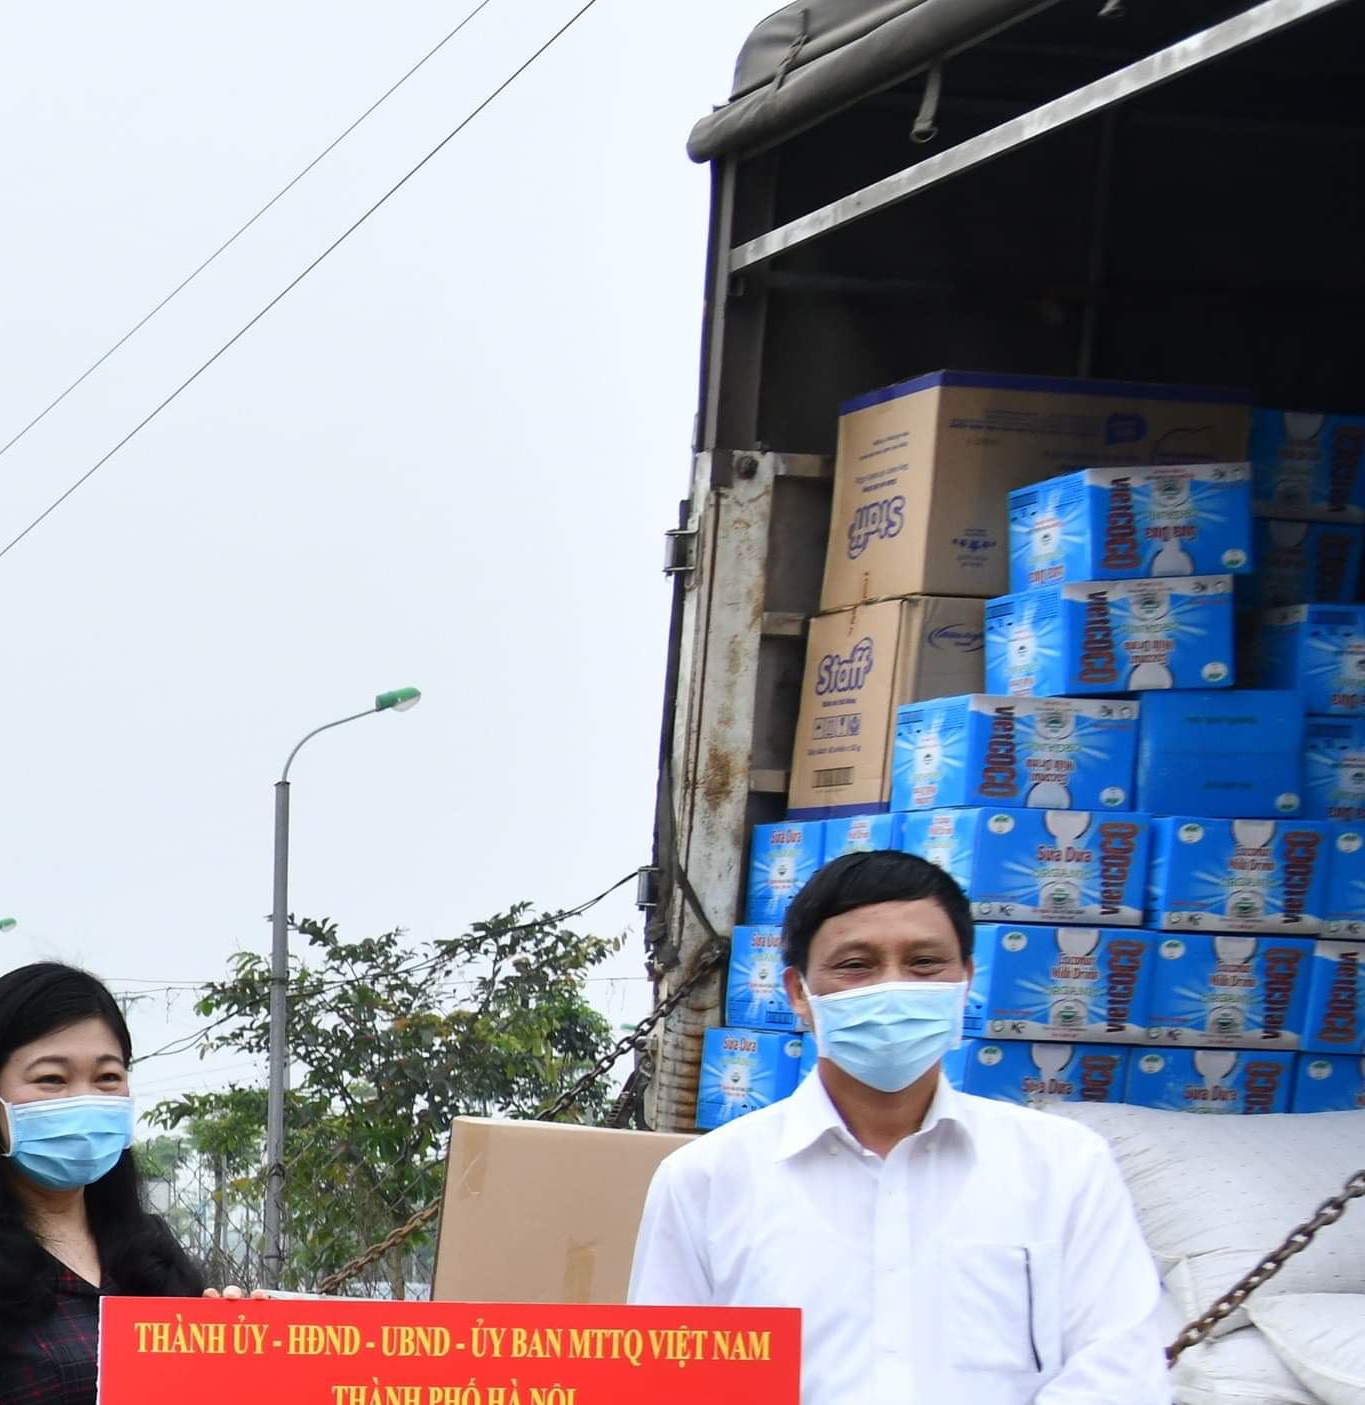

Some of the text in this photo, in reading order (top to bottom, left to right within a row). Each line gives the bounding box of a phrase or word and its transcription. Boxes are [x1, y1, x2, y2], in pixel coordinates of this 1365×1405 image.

[815, 636, 874, 696] Staff
[134, 1314, 226, 1353] THÀNH
[233, 1315, 268, 1354] ỦY
[288, 1325, 360, 1355] HĐND
[381, 1326, 450, 1356] UBND
[471, 1319, 506, 1357] ỦY
[511, 1328, 562, 1357] BAN
[569, 1329, 643, 1366] MTTQ
[649, 1326, 708, 1367] VIỆT
[713, 1331, 770, 1360] NAM
